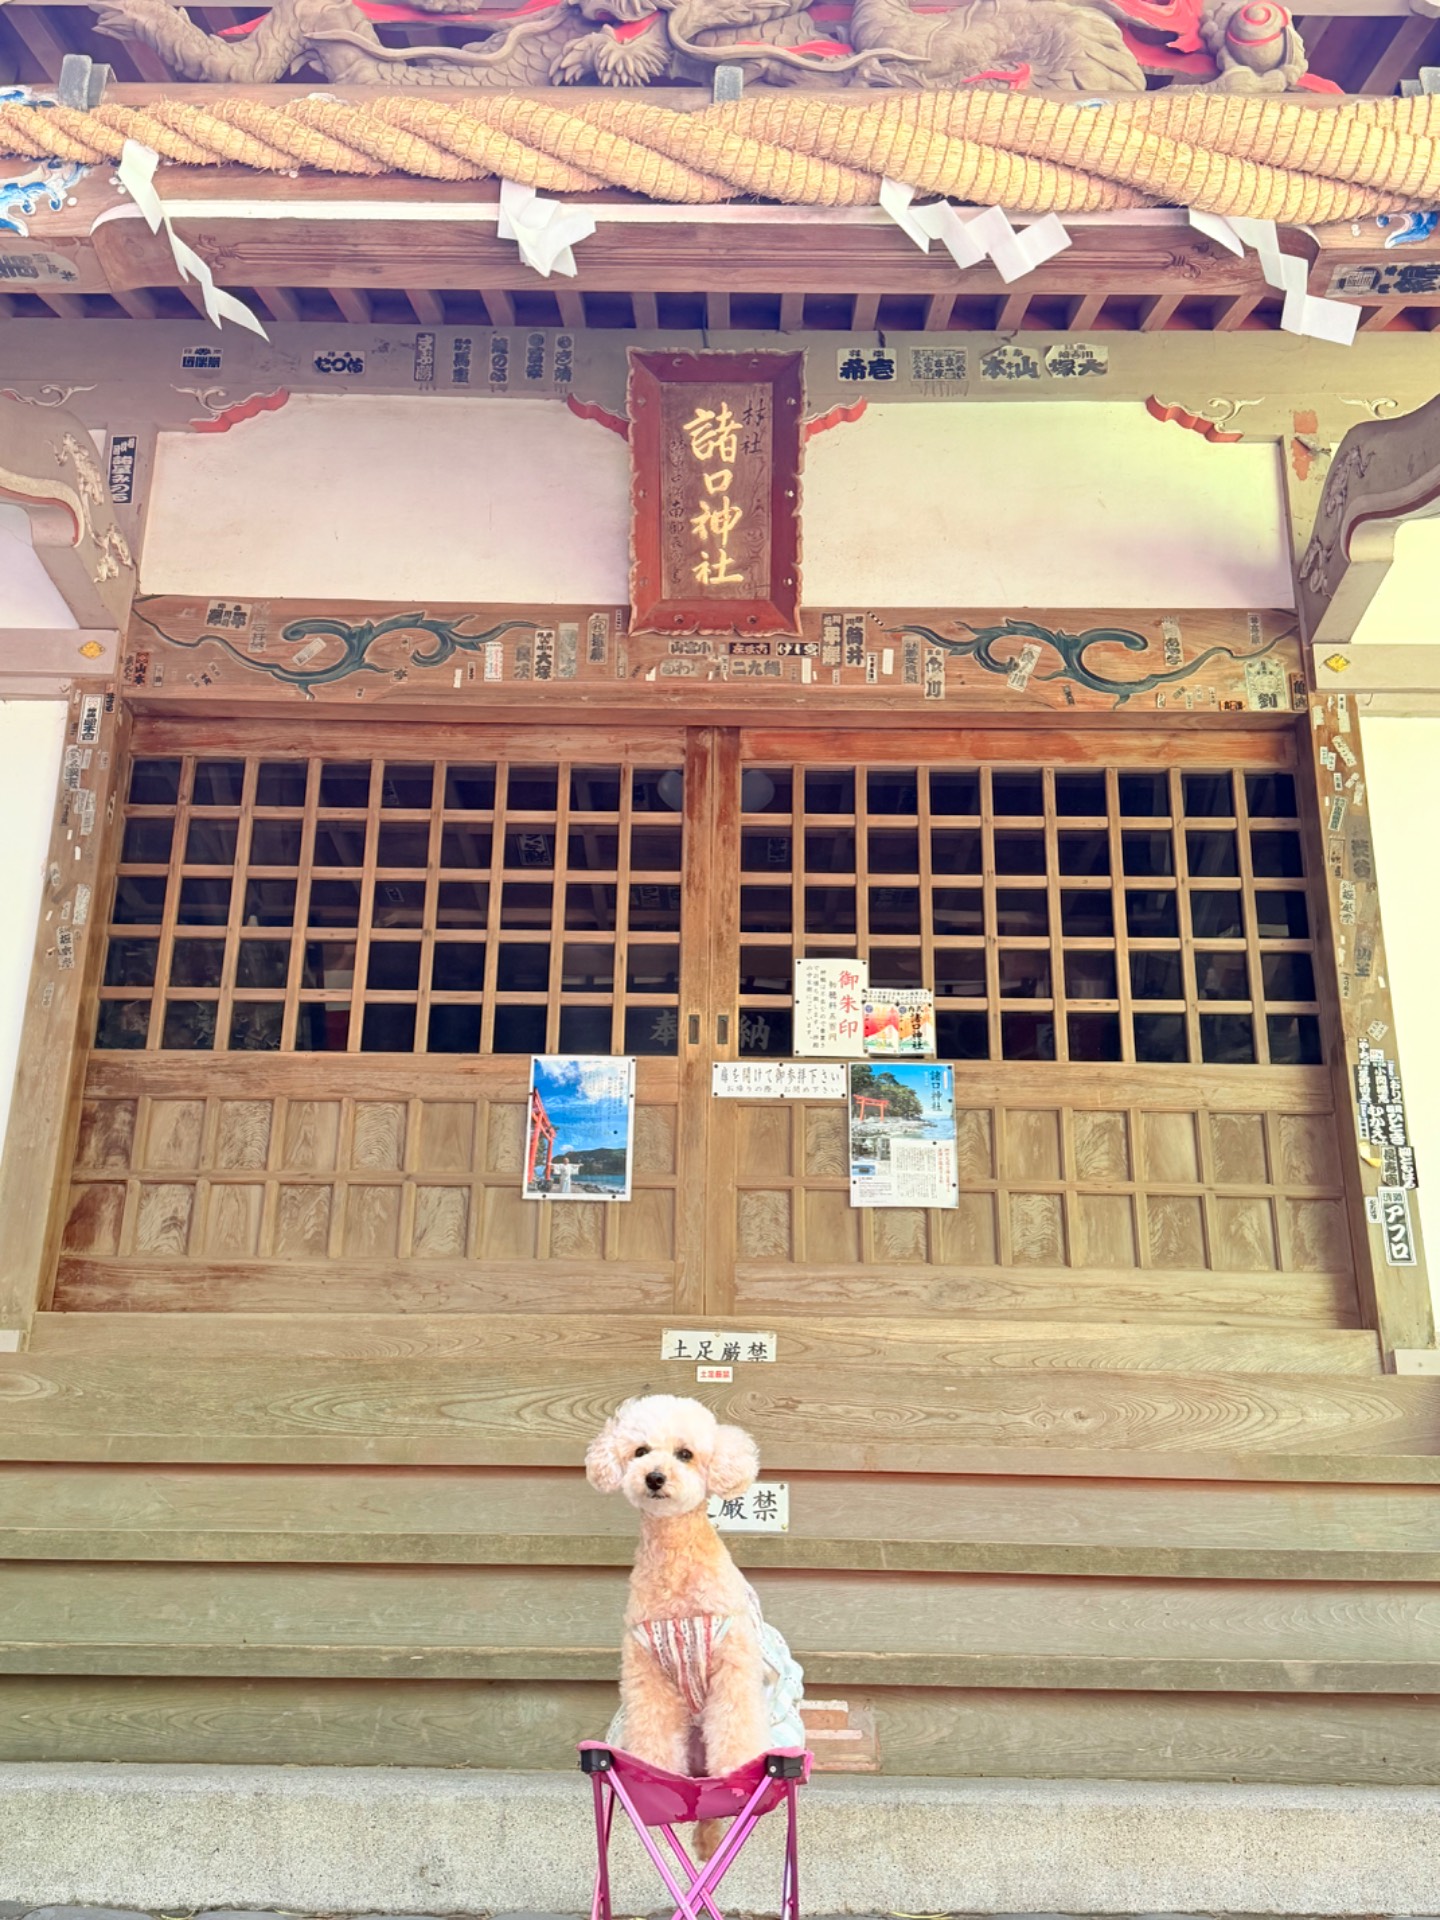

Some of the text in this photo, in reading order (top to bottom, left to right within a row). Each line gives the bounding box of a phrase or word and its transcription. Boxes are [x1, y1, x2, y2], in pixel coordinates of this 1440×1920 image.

[683, 401, 744, 585] 諸口神社
[838, 969, 860, 1040] 御朱印
[1384, 1204, 1410, 1261] アフロ
[668, 1339, 769, 1362] 土足厳禁
[707, 1490, 779, 1522] 厳禁
